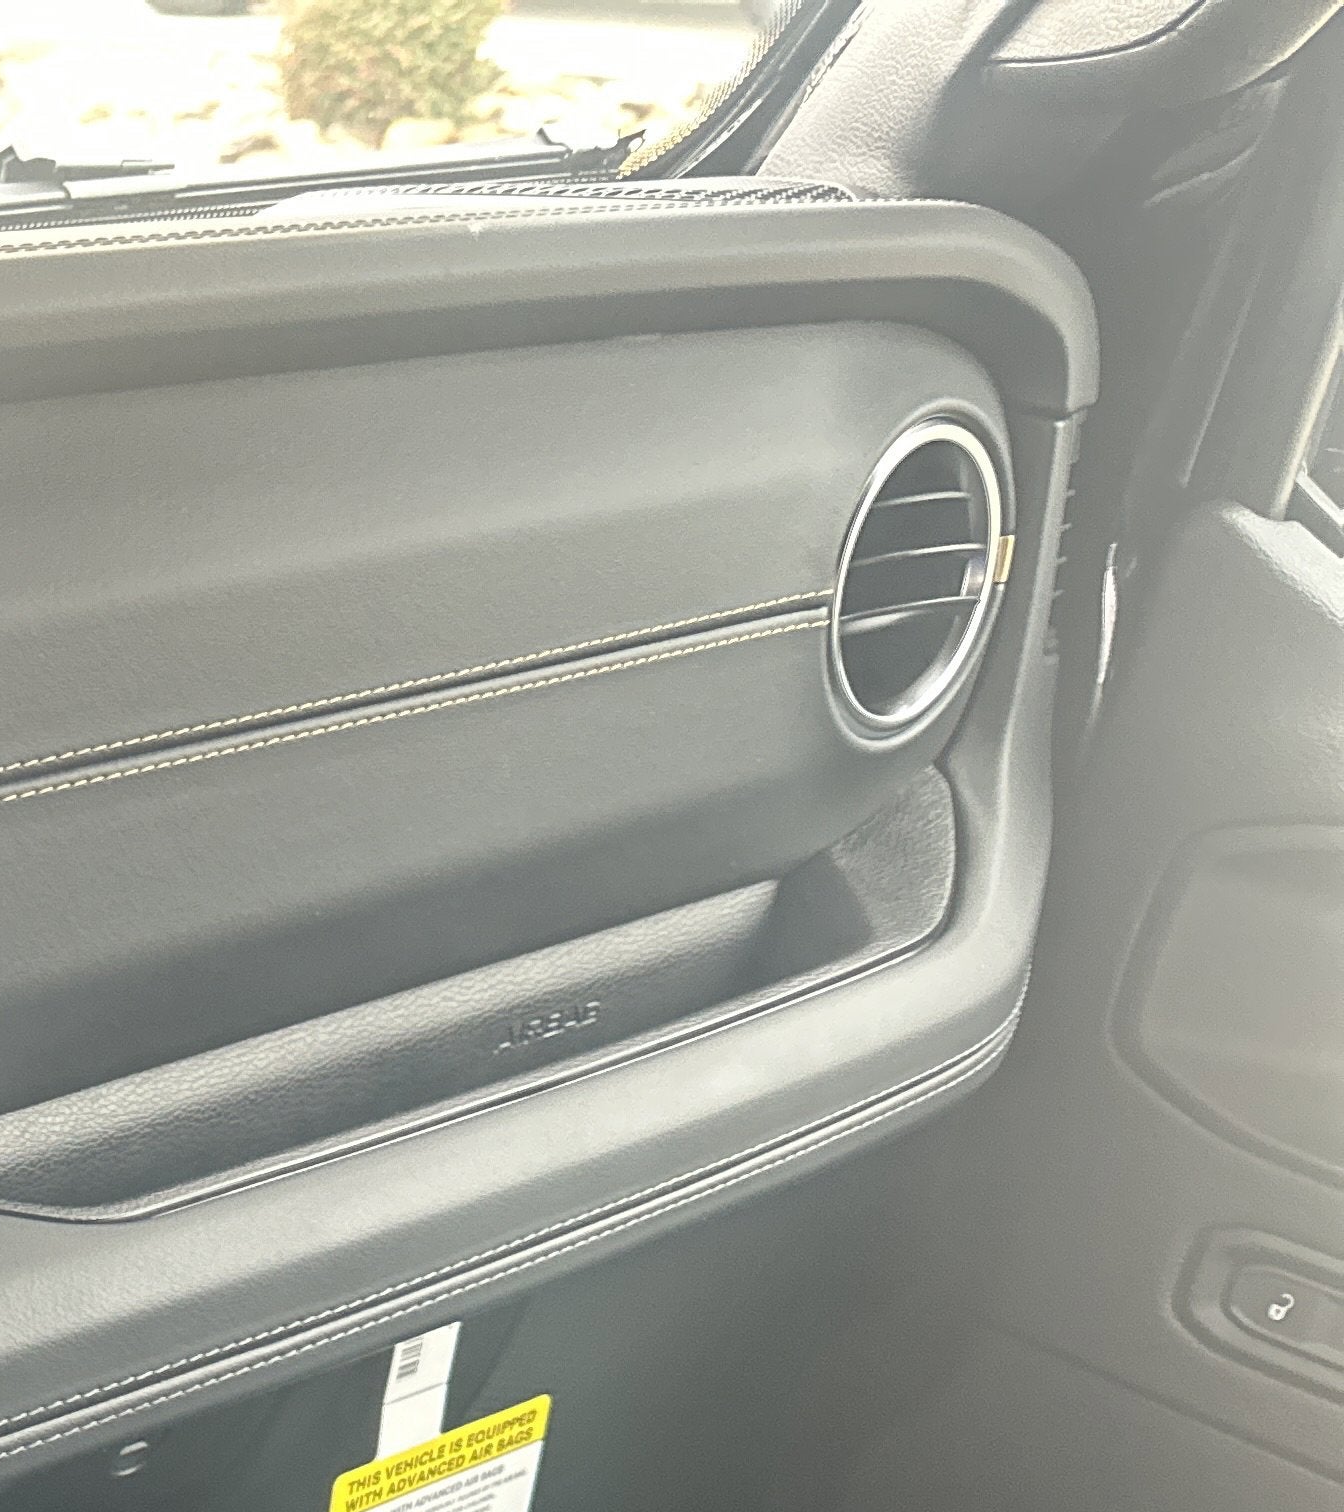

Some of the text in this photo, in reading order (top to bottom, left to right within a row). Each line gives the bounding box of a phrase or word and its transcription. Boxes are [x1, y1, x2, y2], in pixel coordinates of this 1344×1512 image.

[347, 1409, 537, 1495] THIS VEHICLE IS EQUIPPED
[387, 1454, 465, 1497] ADVANCED
[468, 1443, 493, 1463] AIR
[498, 1427, 534, 1451] BAGS
[415, 1482, 463, 1508] ADVANCED
